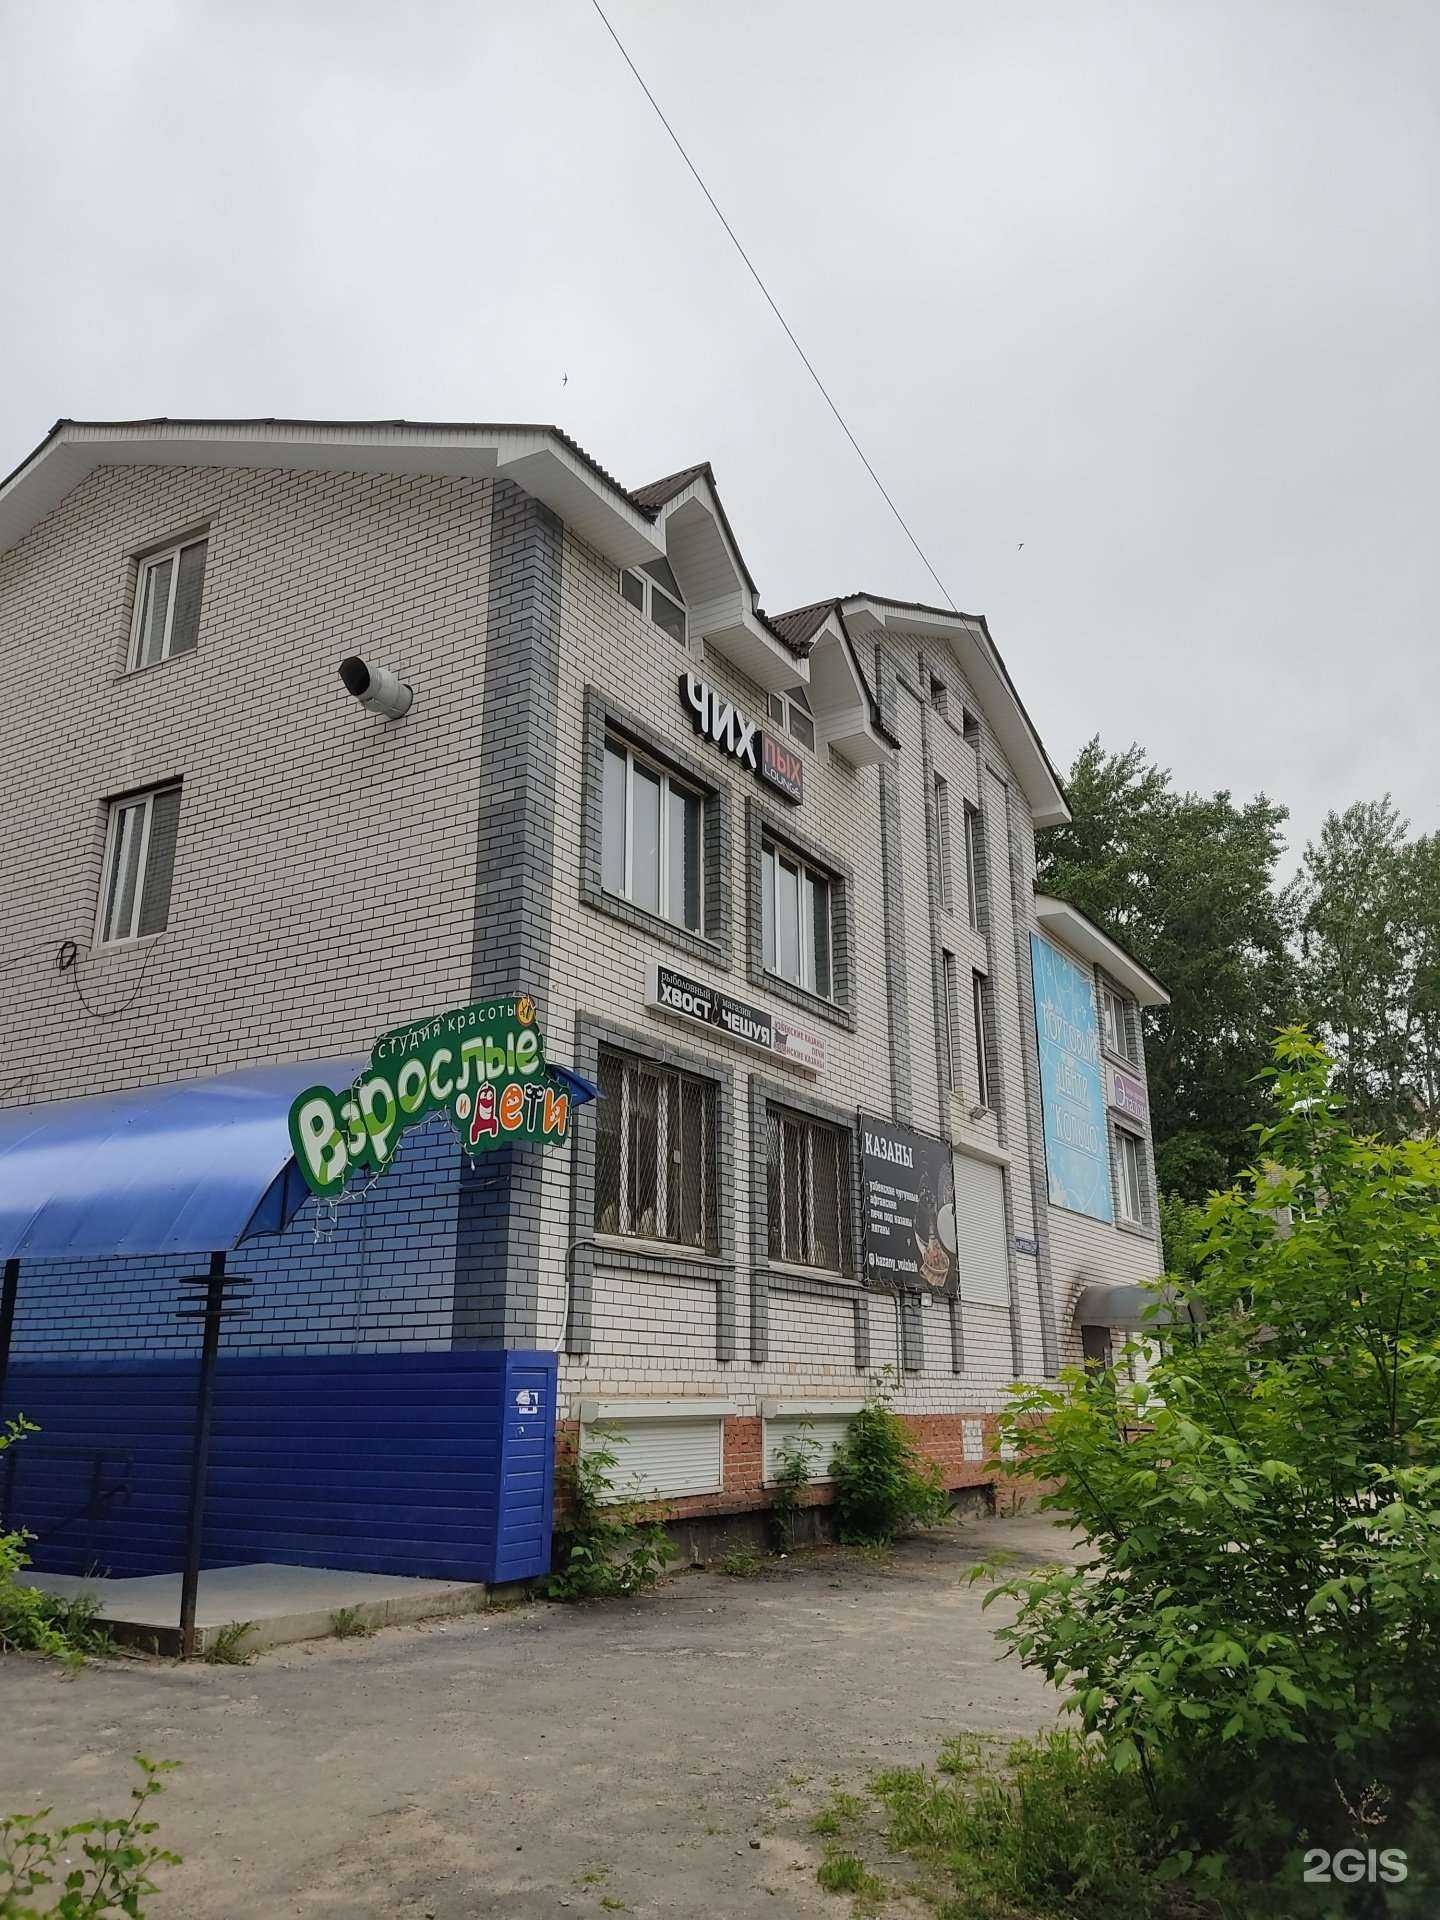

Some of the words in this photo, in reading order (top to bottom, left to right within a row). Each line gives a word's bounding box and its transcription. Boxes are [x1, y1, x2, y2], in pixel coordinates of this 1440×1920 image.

[687, 671, 757, 769] ЧИХ
[764, 736, 801, 786] ПЫХ
[764, 763, 801, 796] LOUNGE
[660, 983, 712, 1020] ХВОСТ
[721, 1008, 770, 1047] ЧЕШУЯ
[661, 971, 711, 1001] рыболовный
[721, 998, 752, 1018] магазин
[377, 1022, 441, 1059] студия
[447, 1003, 516, 1034] красоты
[865, 1132, 914, 1169] КАЗАНЫ
